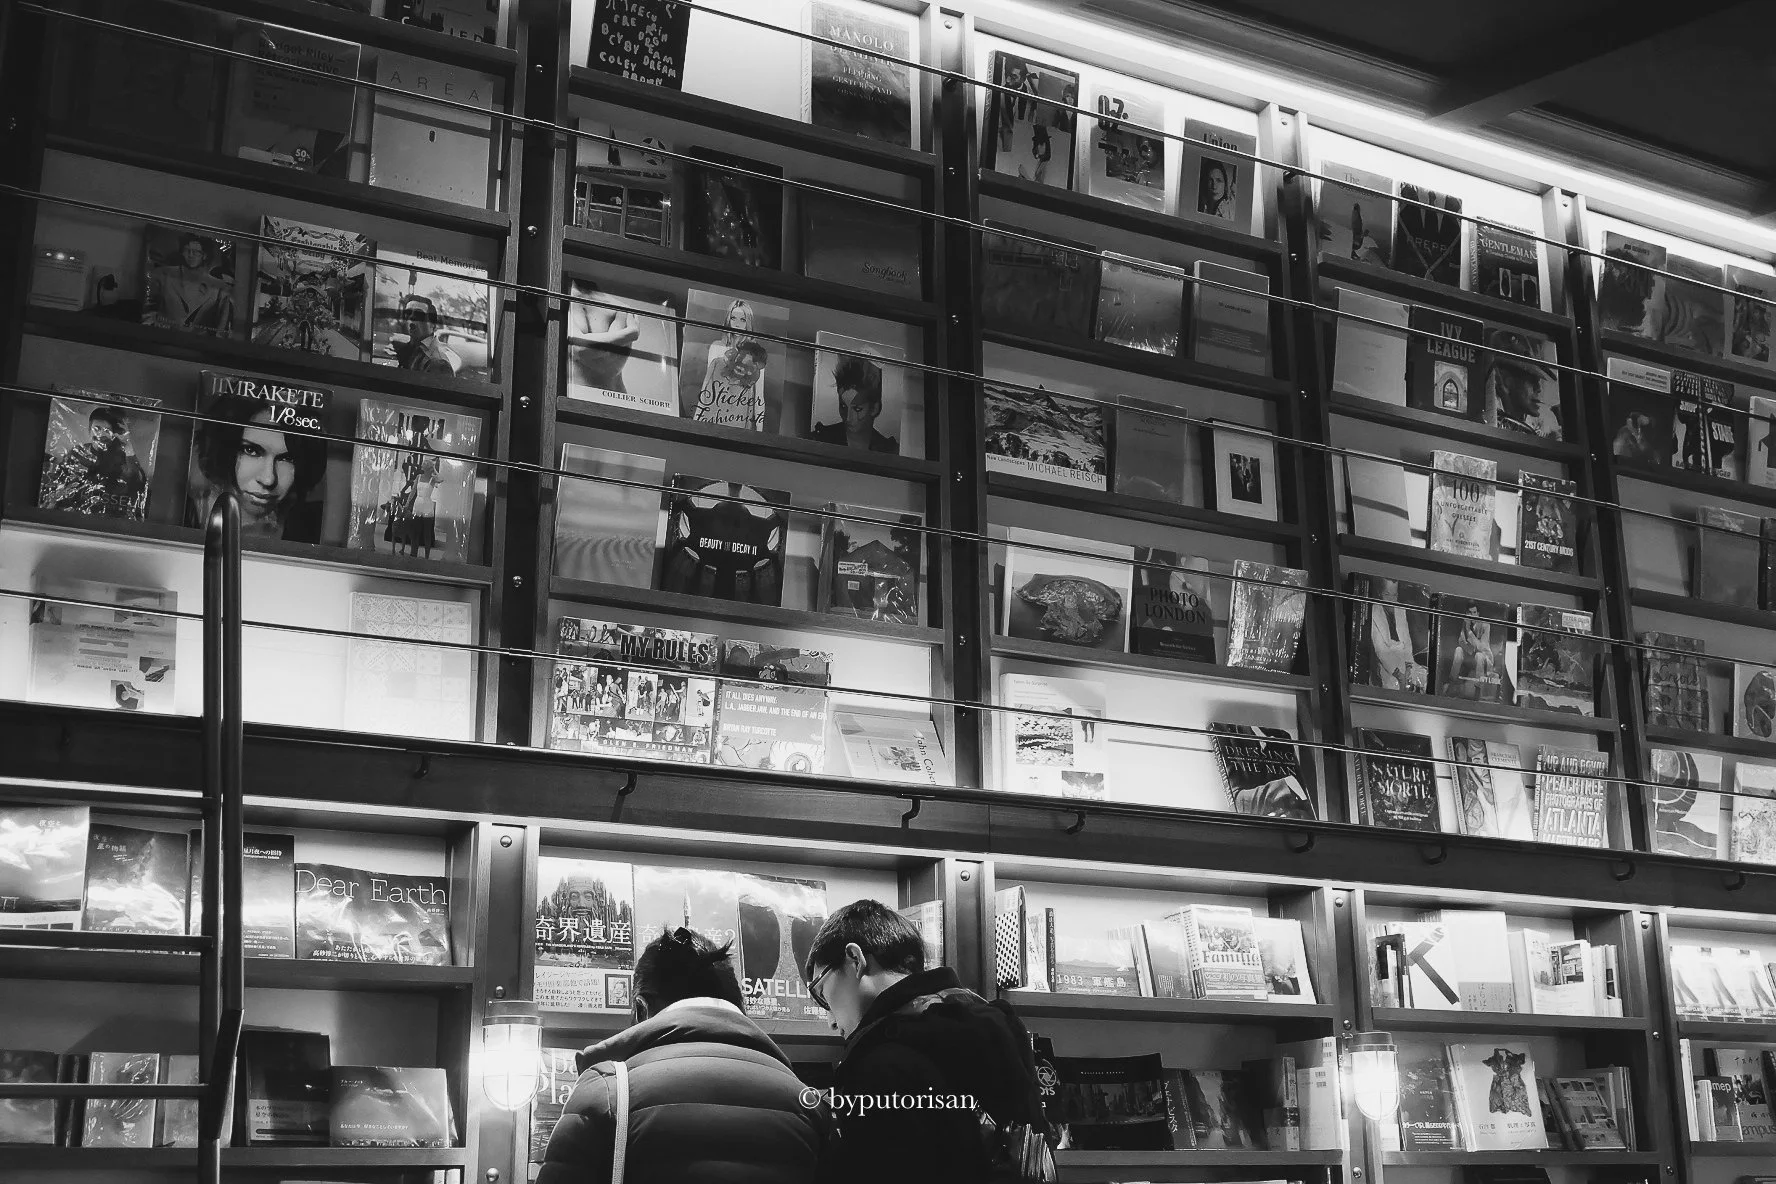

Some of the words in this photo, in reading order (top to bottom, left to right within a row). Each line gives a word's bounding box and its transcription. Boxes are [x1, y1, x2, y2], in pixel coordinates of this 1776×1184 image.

[829, 25, 894, 51] MANOLO
[390, 69, 480, 101] AREA
[1480, 238, 1538, 260] GENTLEMAN
[1440, 321, 1463, 339] IVY
[1427, 338, 1477, 364] LEAGUE
[602, 390, 636, 403] COLLIER
[639, 397, 671, 409] SCHORR
[699, 380, 766, 408] Sticker
[1027, 461, 1068, 478] MICHAEL
[1069, 468, 1104, 485] REISCH
[1453, 479, 1480, 503] 100
[699, 537, 723, 550] BEAUTY
[731, 542, 751, 555] DECAY
[1150, 587, 1199, 608] PHOTO
[1144, 602, 1206, 624] LONDON
[620, 633, 651, 658] MY
[652, 637, 710, 665] RULES
[645, 743, 695, 754] FRIEDMAN
[1225, 745, 1294, 761] DRESSING
[1230, 760, 1261, 773] THE
[1265, 763, 1297, 776] MAN
[1545, 775, 1605, 797] PEACHTREE
[1543, 806, 1601, 836] ATLANTA
[296, 869, 360, 899] Dear
[370, 878, 448, 905] Earth
[535, 915, 632, 945] 奇界遺産
[741, 977, 813, 999] SATELLI
[1057, 974, 1083, 986] 1983
[1742, 1124, 1776, 1138] ampus
